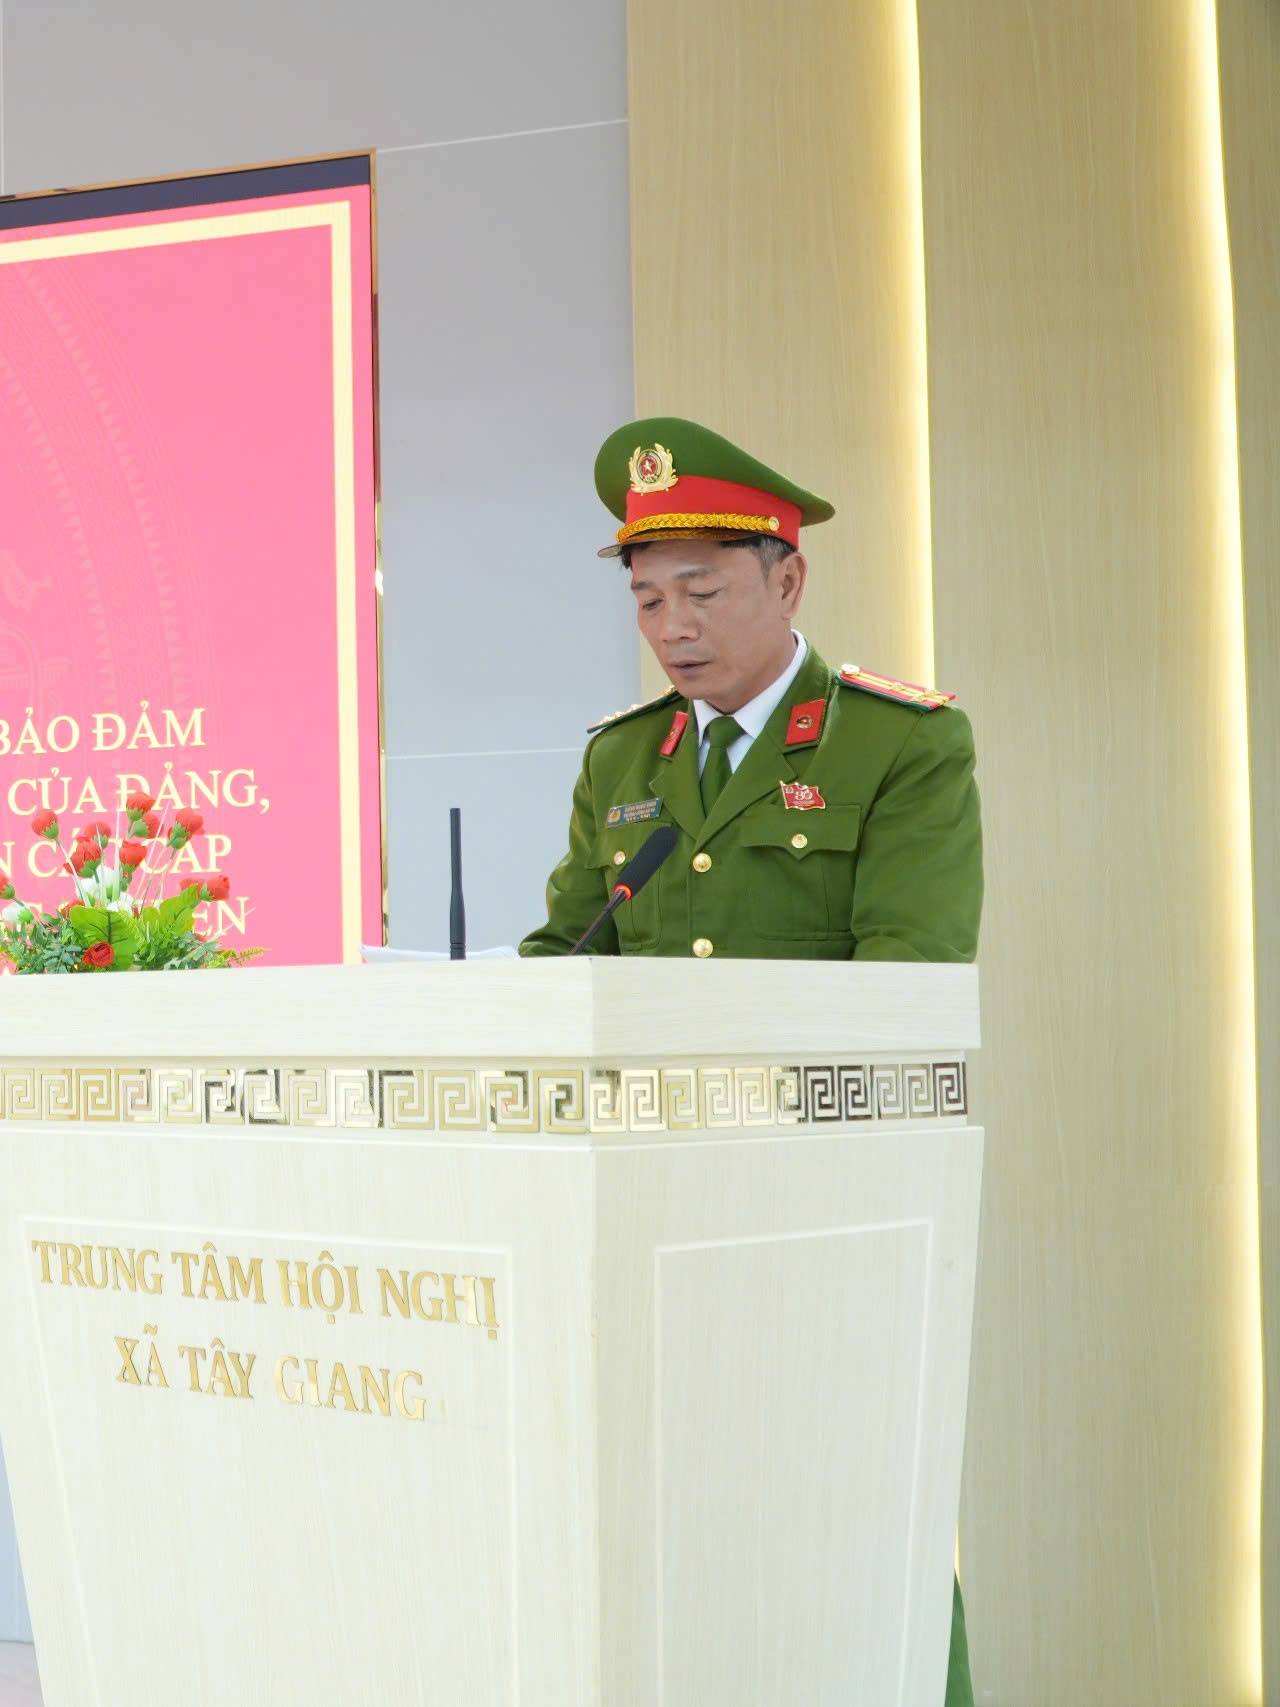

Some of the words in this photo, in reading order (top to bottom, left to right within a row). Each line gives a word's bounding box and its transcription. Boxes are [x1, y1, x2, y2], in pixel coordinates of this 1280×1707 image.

[93, 700, 206, 751] ĐẢM
[8, 768, 106, 816] CỦA
[31, 1240, 163, 1296] TRUNG
[171, 1241, 267, 1304] TÂM
[276, 1250, 363, 1324] HỘI
[376, 1268, 501, 1341] NGHỊ
[114, 1322, 170, 1388] XÃ
[178, 1337, 257, 1399] TÂY
[274, 1355, 427, 1421] GIANG
